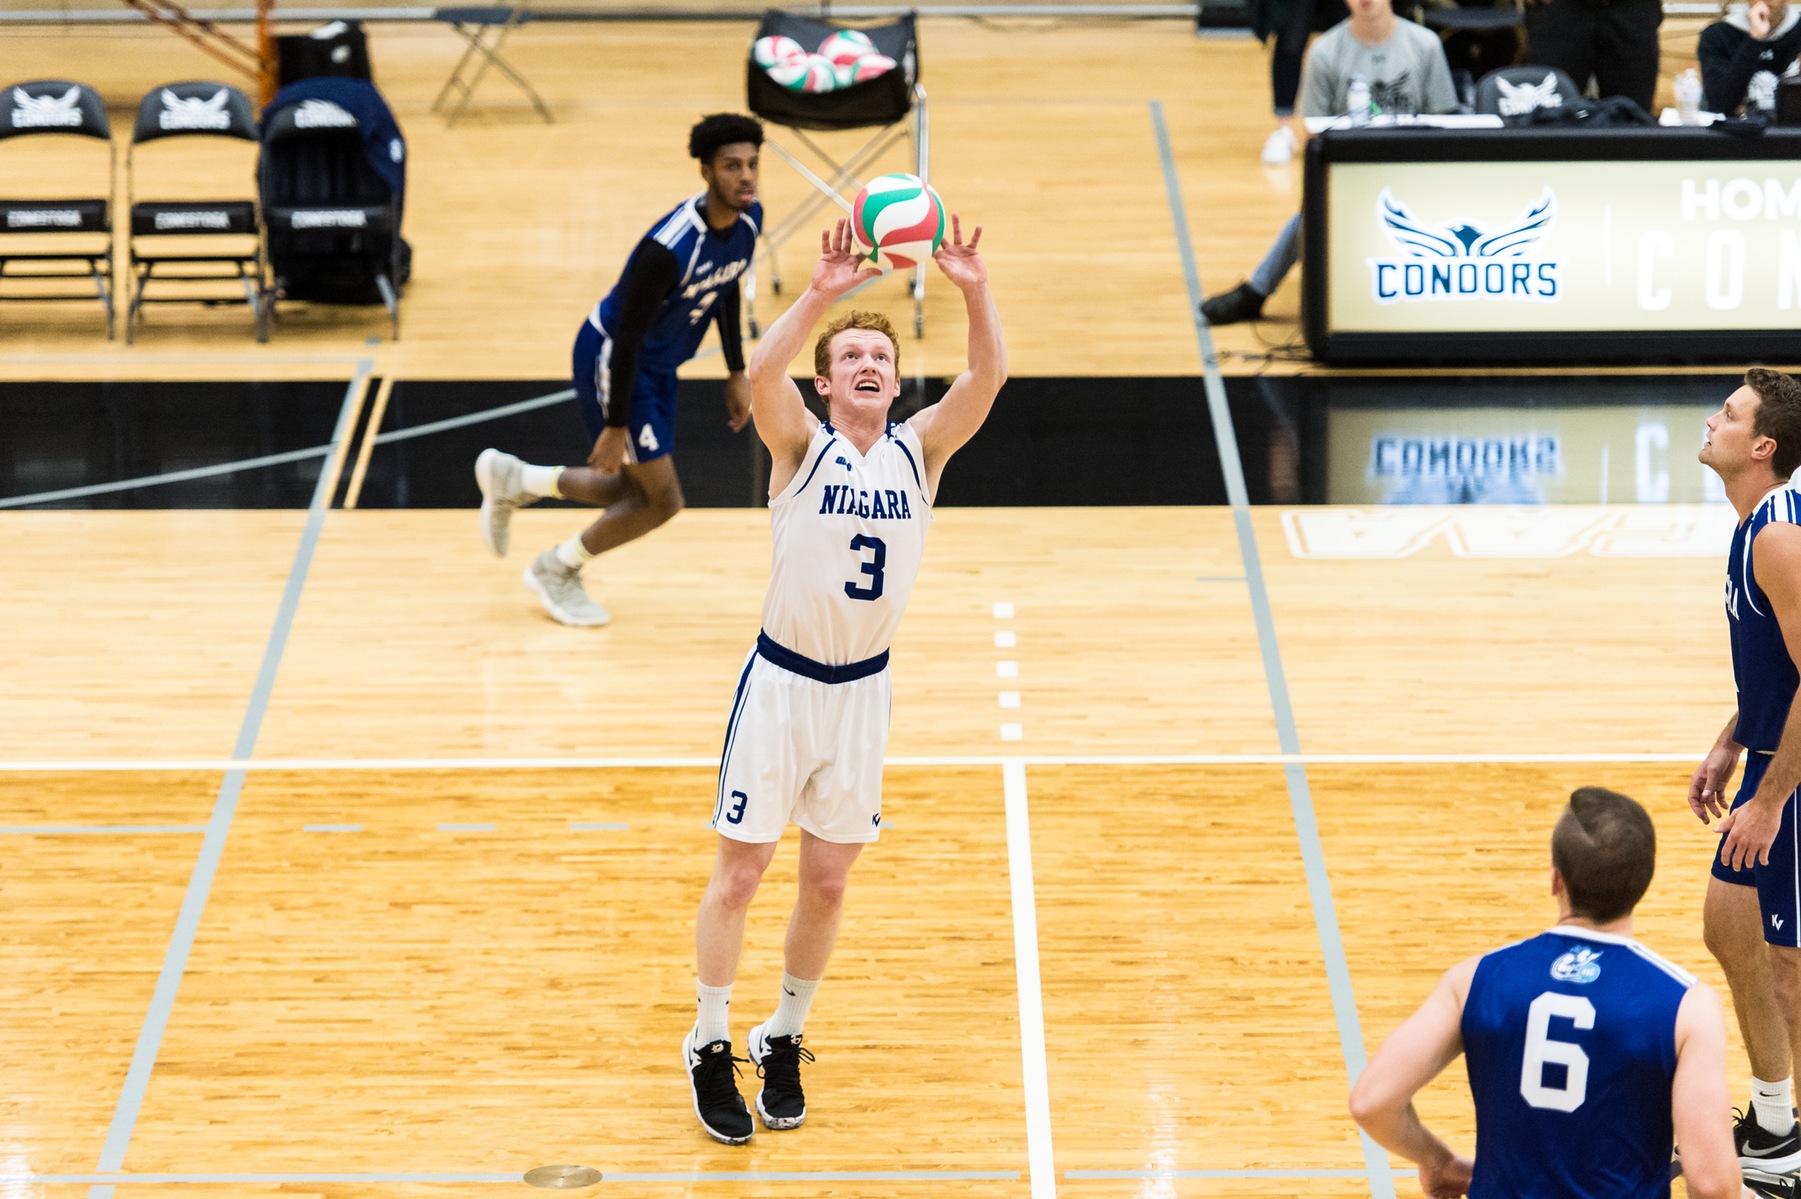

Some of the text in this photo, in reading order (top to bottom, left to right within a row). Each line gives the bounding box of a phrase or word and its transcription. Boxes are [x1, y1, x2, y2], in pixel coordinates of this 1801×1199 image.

[1681, 178, 1801, 221] HOM
[1378, 264, 1557, 297] CONDORS
[638, 423, 660, 451] 4
[819, 485, 911, 519] NIAGARA
[844, 533, 886, 601] 3
[726, 790, 748, 824] 3
[1520, 991, 1596, 1113] 6
